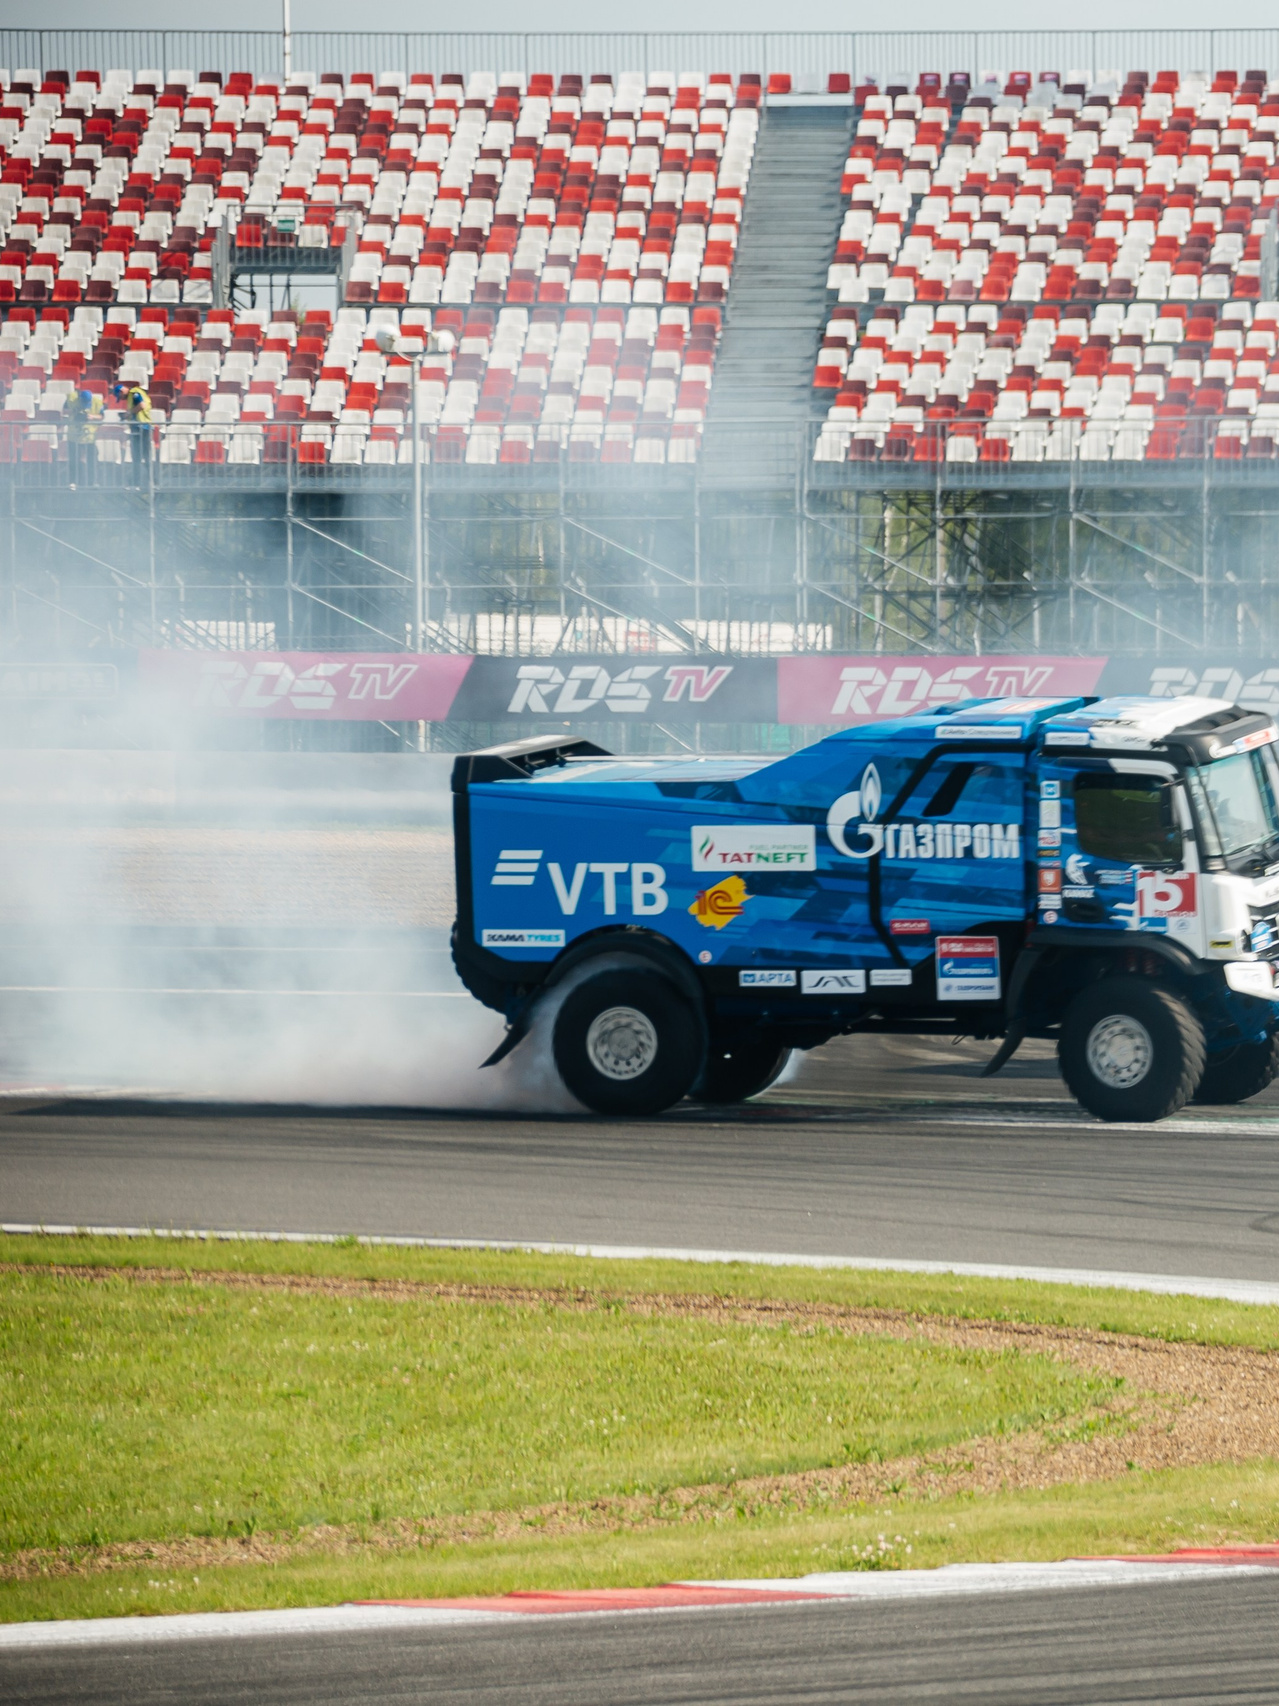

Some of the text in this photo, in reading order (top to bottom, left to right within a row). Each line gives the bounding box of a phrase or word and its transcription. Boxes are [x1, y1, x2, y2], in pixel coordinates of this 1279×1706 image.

[194, 661, 419, 709] RDS TV
[507, 665, 734, 714] RDS TV
[831, 666, 1055, 714] RDS TV
[718, 852, 808, 864] TATNEFT
[885, 823, 1020, 859] ГАЗПРОМ
[547, 863, 669, 916] VTB
[487, 934, 525, 942] KAMA
